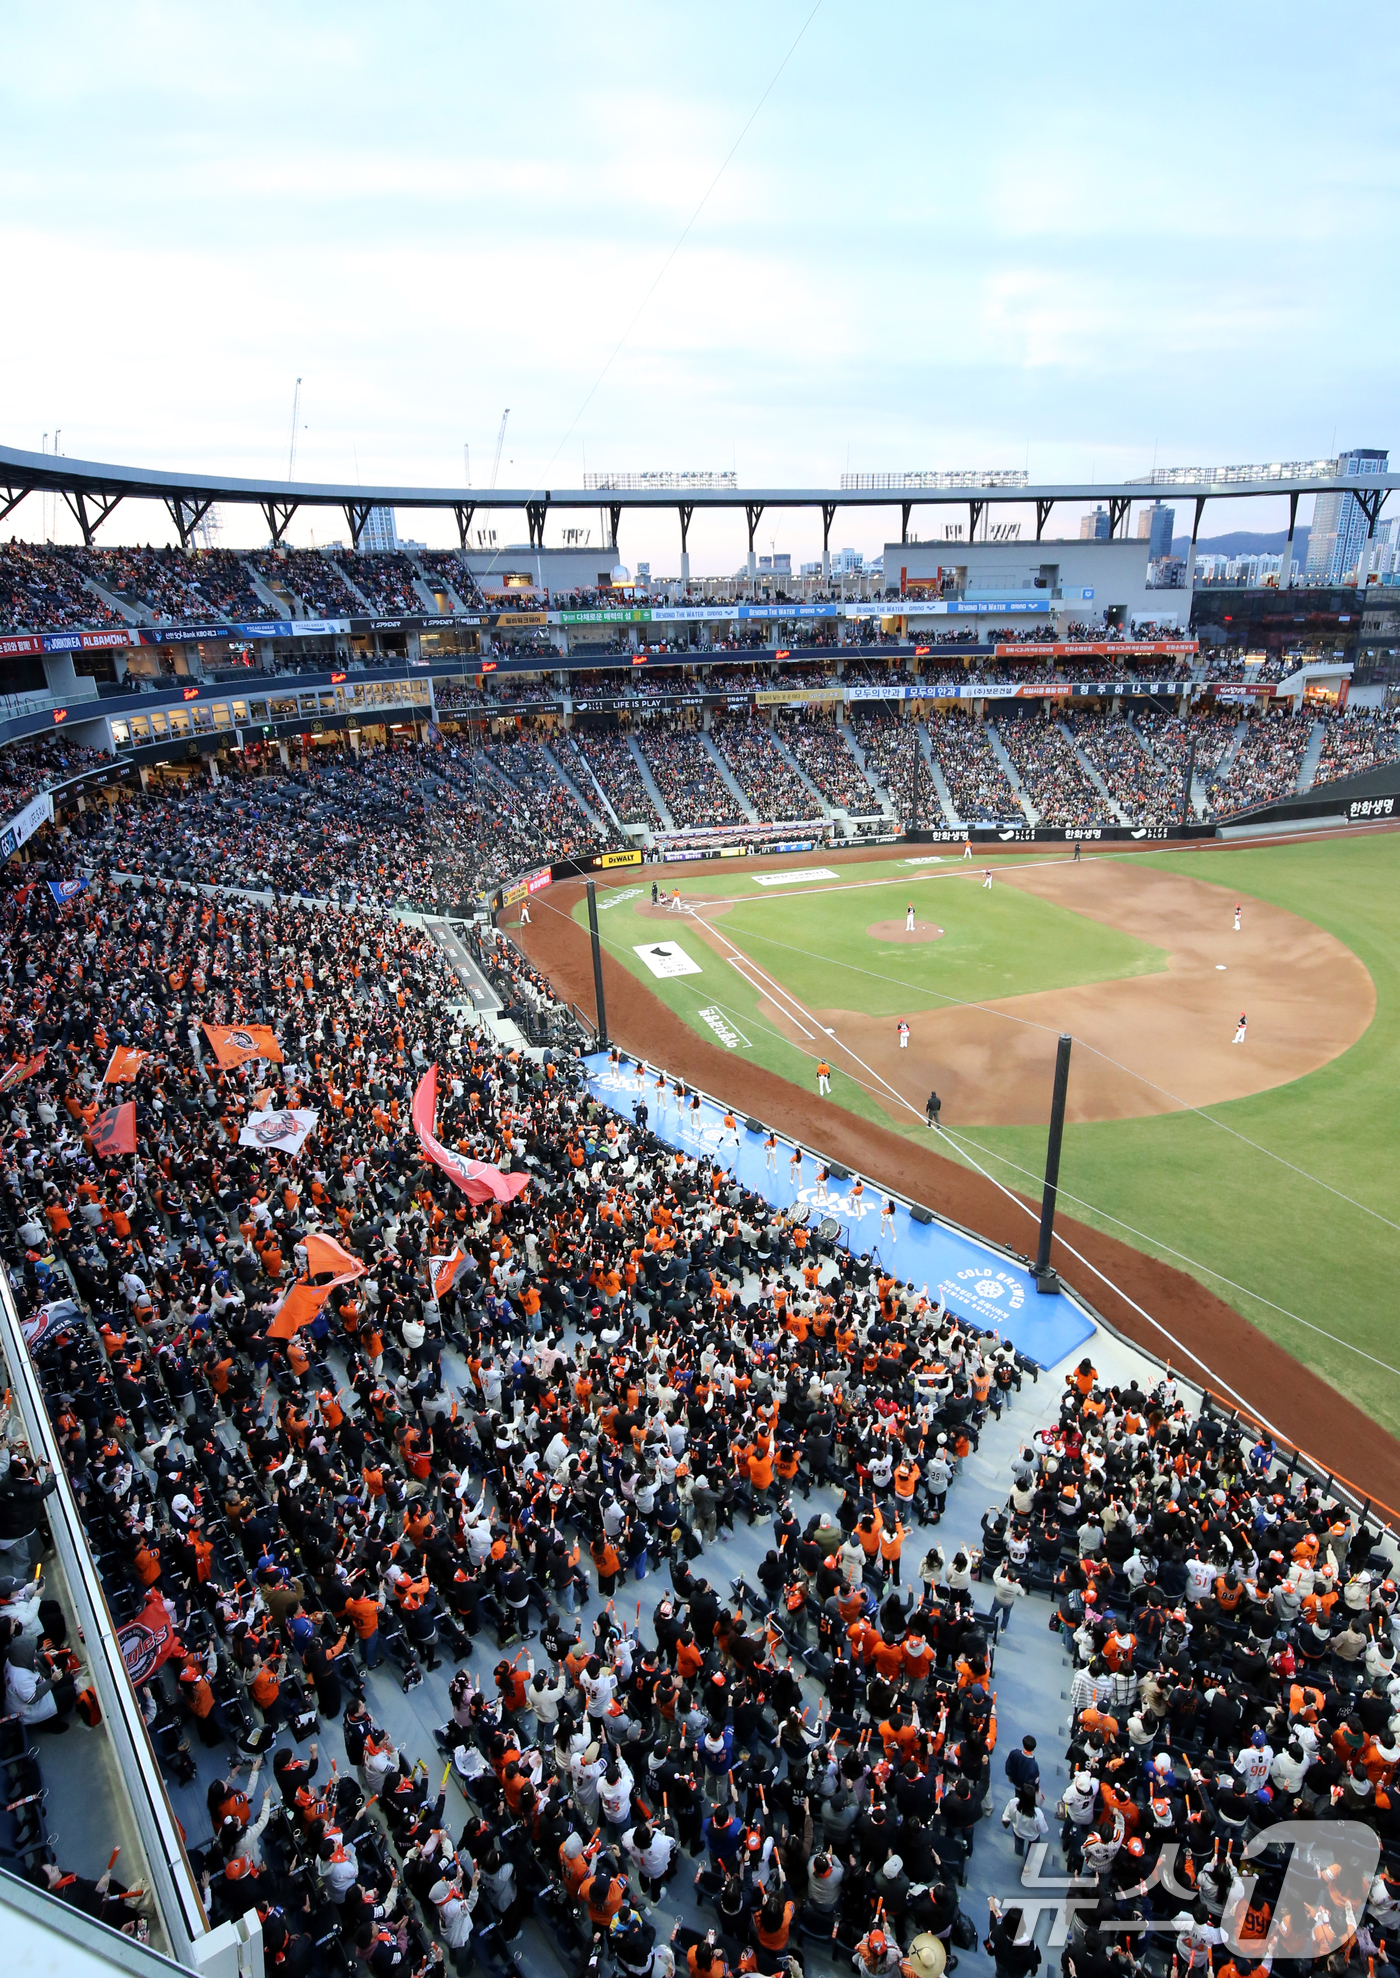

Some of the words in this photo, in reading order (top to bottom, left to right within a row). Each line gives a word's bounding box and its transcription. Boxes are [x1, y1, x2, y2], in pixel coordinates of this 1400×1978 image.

[51, 636, 81, 649] JOBKOREA
[83, 634, 122, 647] ALBAMON
[854, 689, 880, 698] 모두의
[882, 688, 900, 698] 안과
[909, 688, 935, 698] 모두의
[937, 687, 956, 697] 안과
[1350, 798, 1395, 818] 한화생명
[932, 831, 969, 841] 한화생명
[1065, 829, 1101, 839] 한화생명
[956, 1267, 992, 1280] COLD
[995, 1271, 1025, 1309] BREWED
[971, 1303, 1004, 1323] QUALITY
[1194, 1574, 1208, 1587] 51
[820, 1620, 831, 1635] 51
[545, 1640, 558, 1652] 99
[635, 1677, 644, 1691] 8
[1249, 1765, 1267, 1777] 99
[1245, 1912, 1265, 1934] 99
